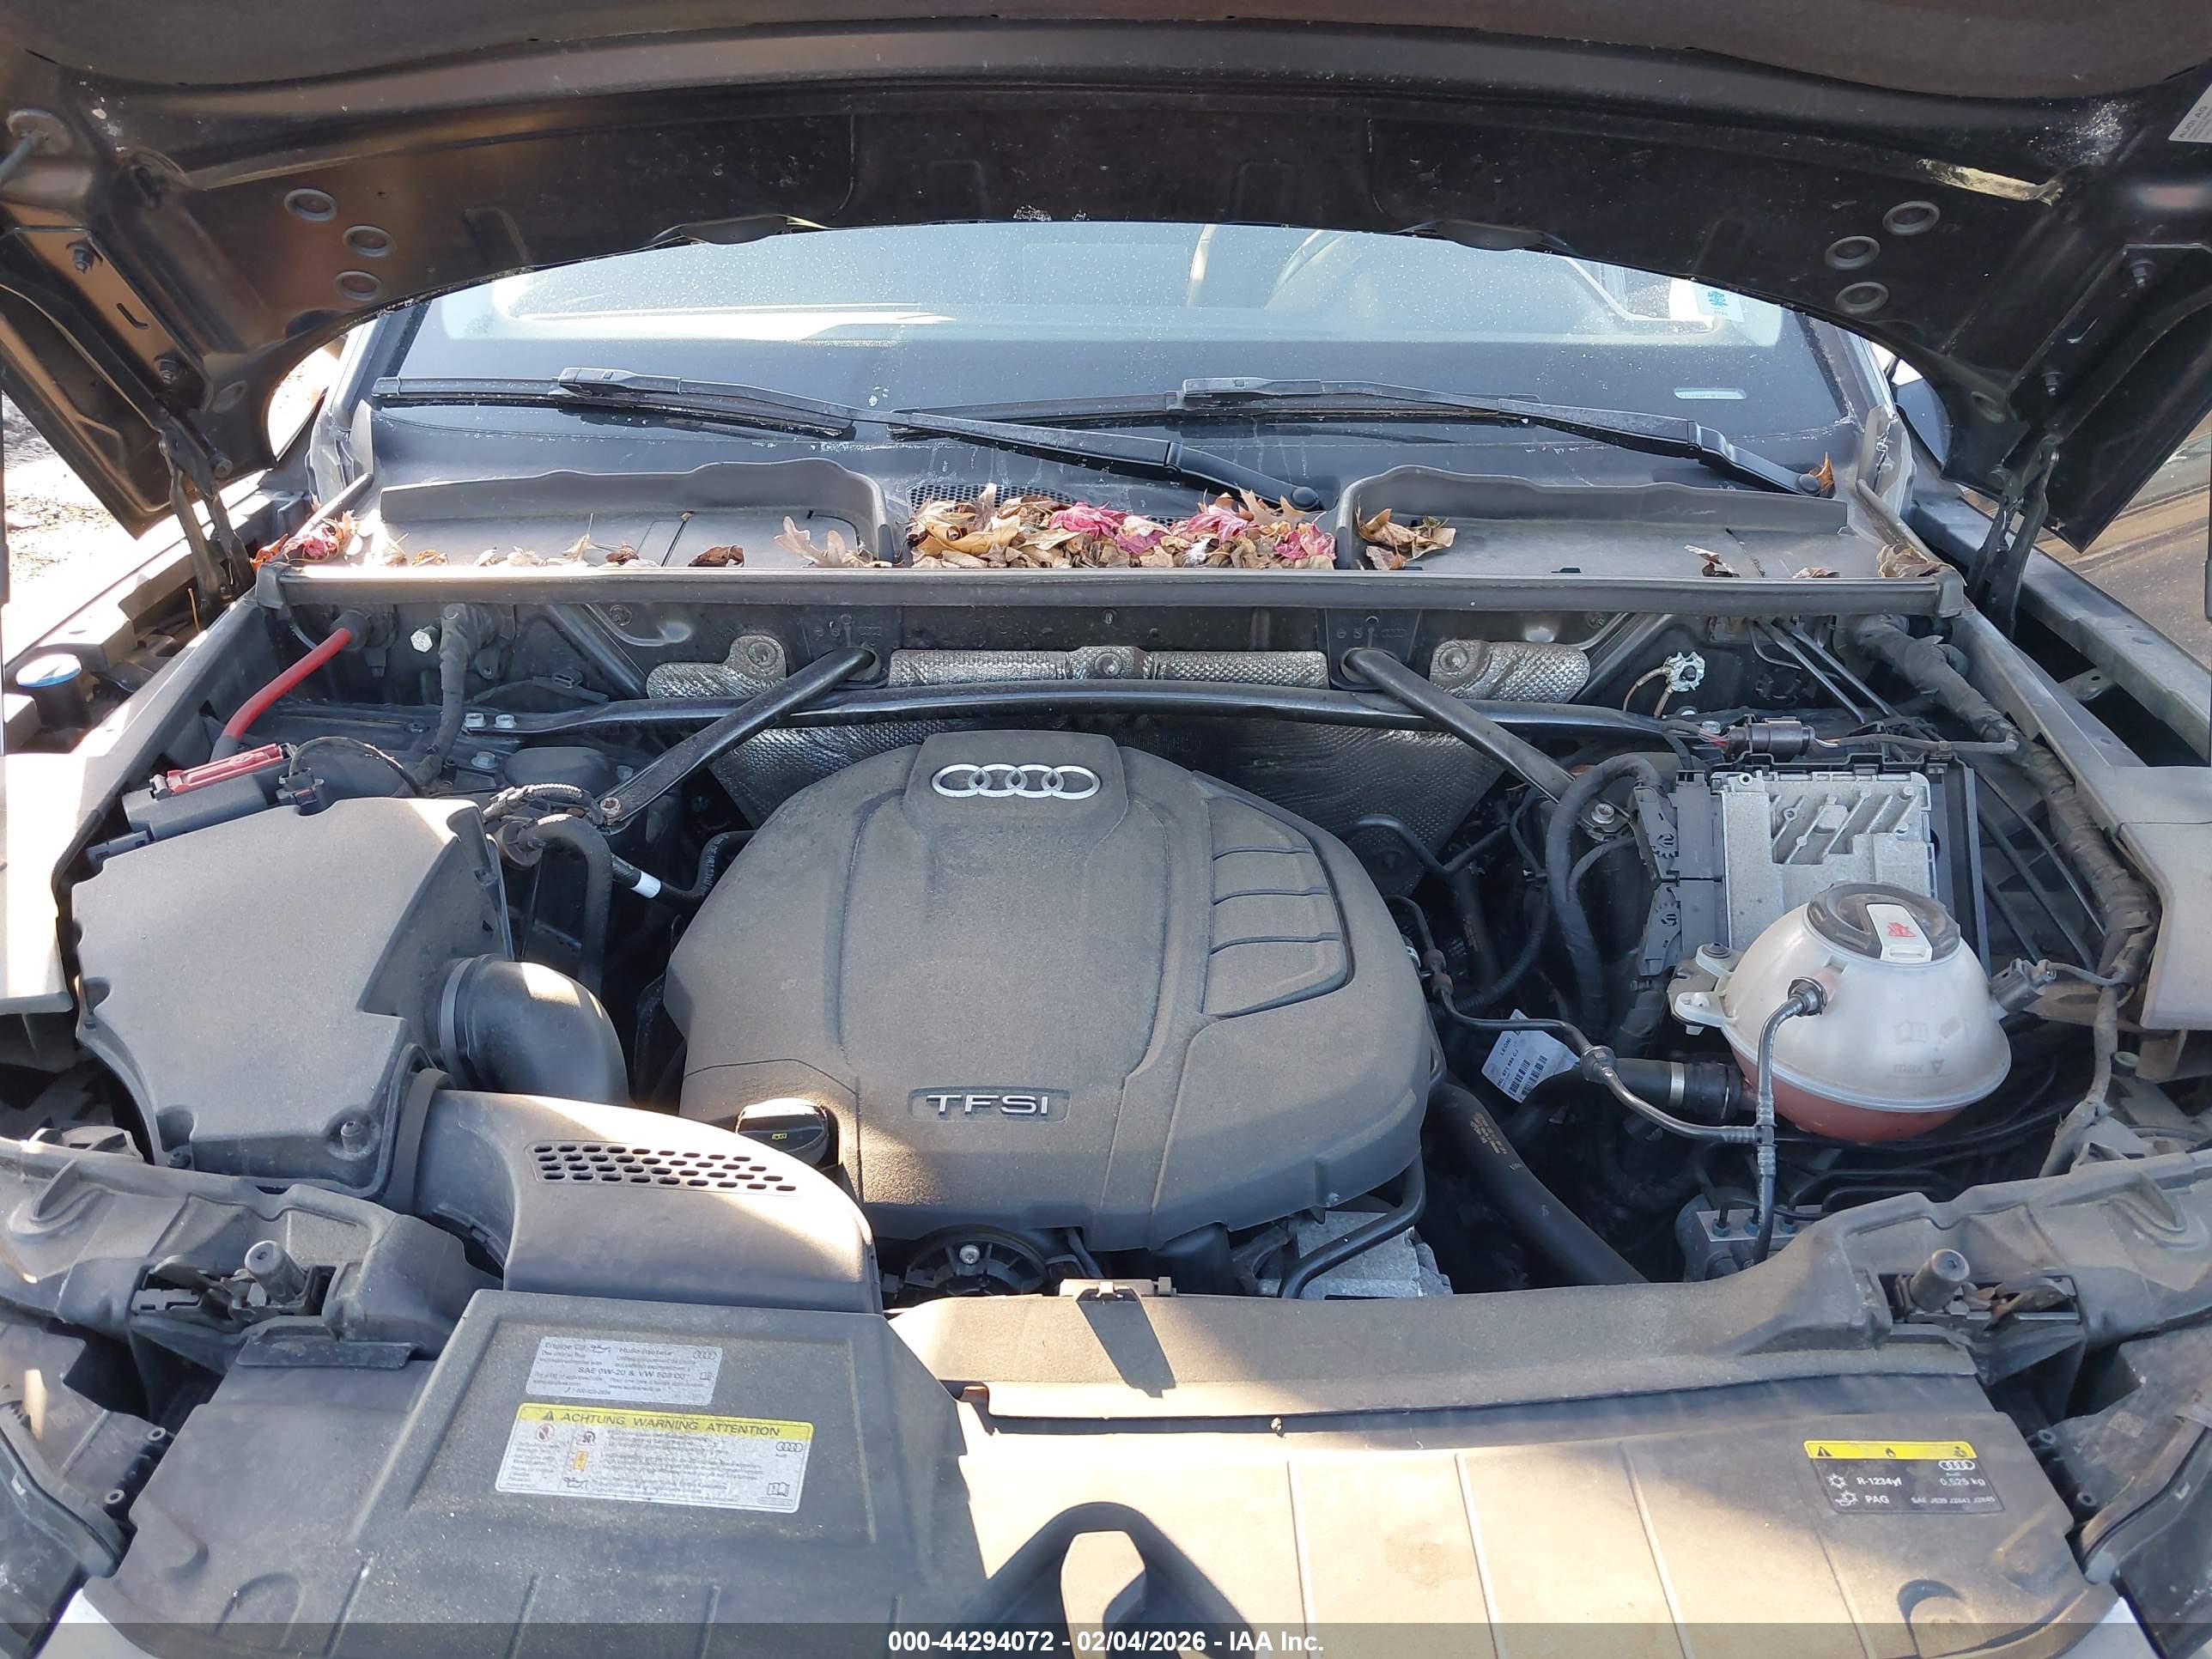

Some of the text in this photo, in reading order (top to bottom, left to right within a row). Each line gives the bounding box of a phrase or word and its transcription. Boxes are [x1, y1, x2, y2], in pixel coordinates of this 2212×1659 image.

[1500, 1036, 1511, 1055] LEONI
[1894, 1064, 1923, 1073] max
[927, 1094, 1048, 1115] TFSI
[561, 1413, 781, 1437] ACHTUNG WARNING ATTENTION
[1856, 1477, 1903, 1487] R-1234yf
[1970, 1477, 1986, 1486] kg
[1865, 1495, 1890, 1504] PAG
